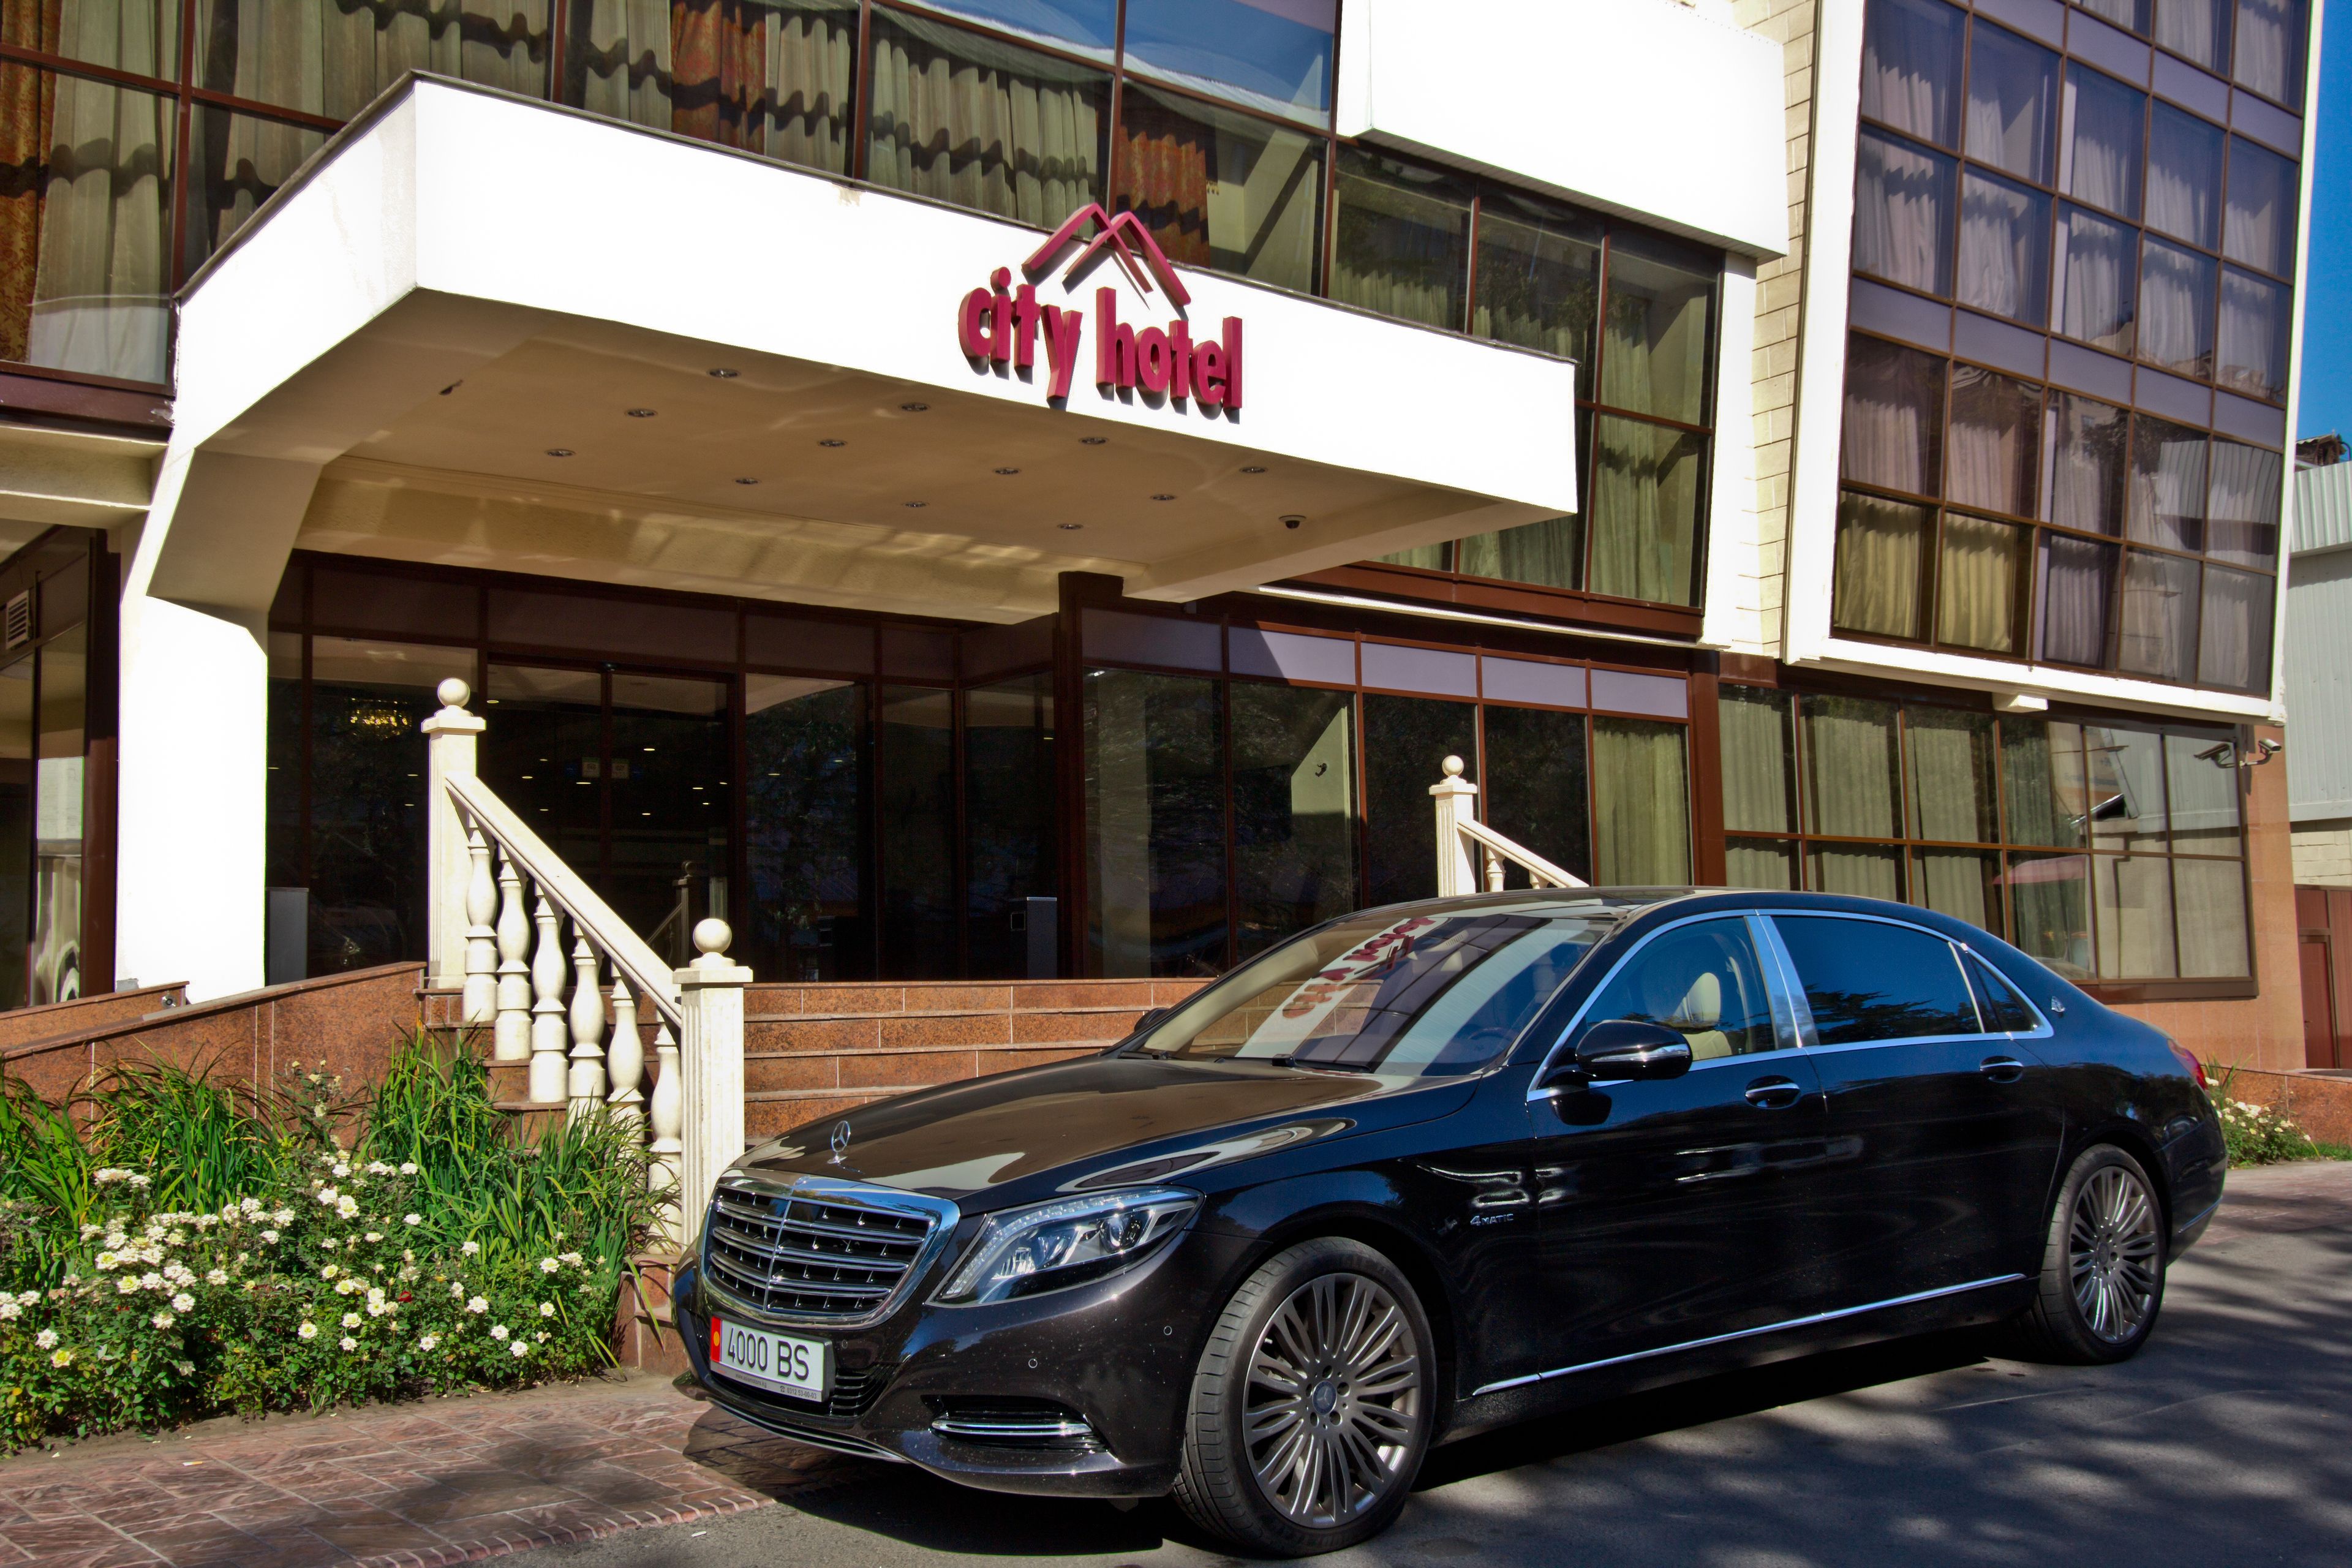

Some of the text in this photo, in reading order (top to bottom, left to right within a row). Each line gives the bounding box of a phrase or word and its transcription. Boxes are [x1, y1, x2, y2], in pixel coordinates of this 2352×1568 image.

[958, 266, 1242, 410] city hotel
[1470, 1213, 1513, 1226] 4MATIC
[728, 1327, 809, 1381] 4000 BS
[797, 1389, 816, 1400] 53-00-03
